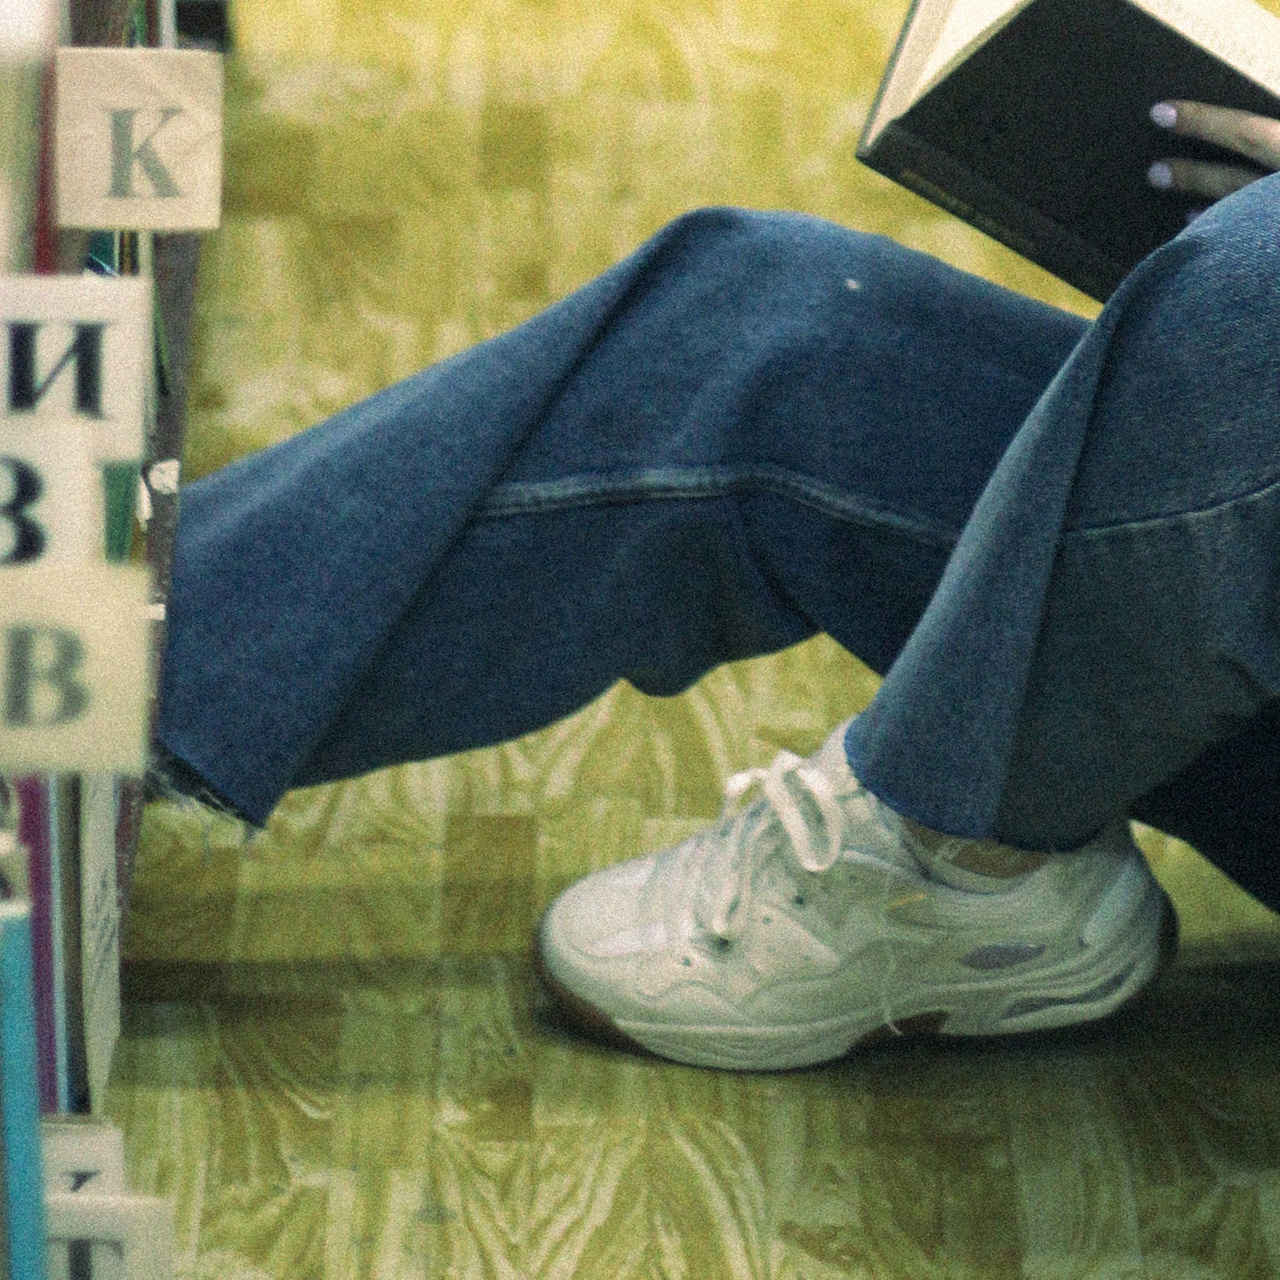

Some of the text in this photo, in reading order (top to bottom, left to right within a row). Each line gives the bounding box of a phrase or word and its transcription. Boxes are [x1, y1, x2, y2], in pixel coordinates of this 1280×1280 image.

[105, 107, 184, 202] К
[7, 320, 110, 419] И
[4, 625, 91, 728] В
